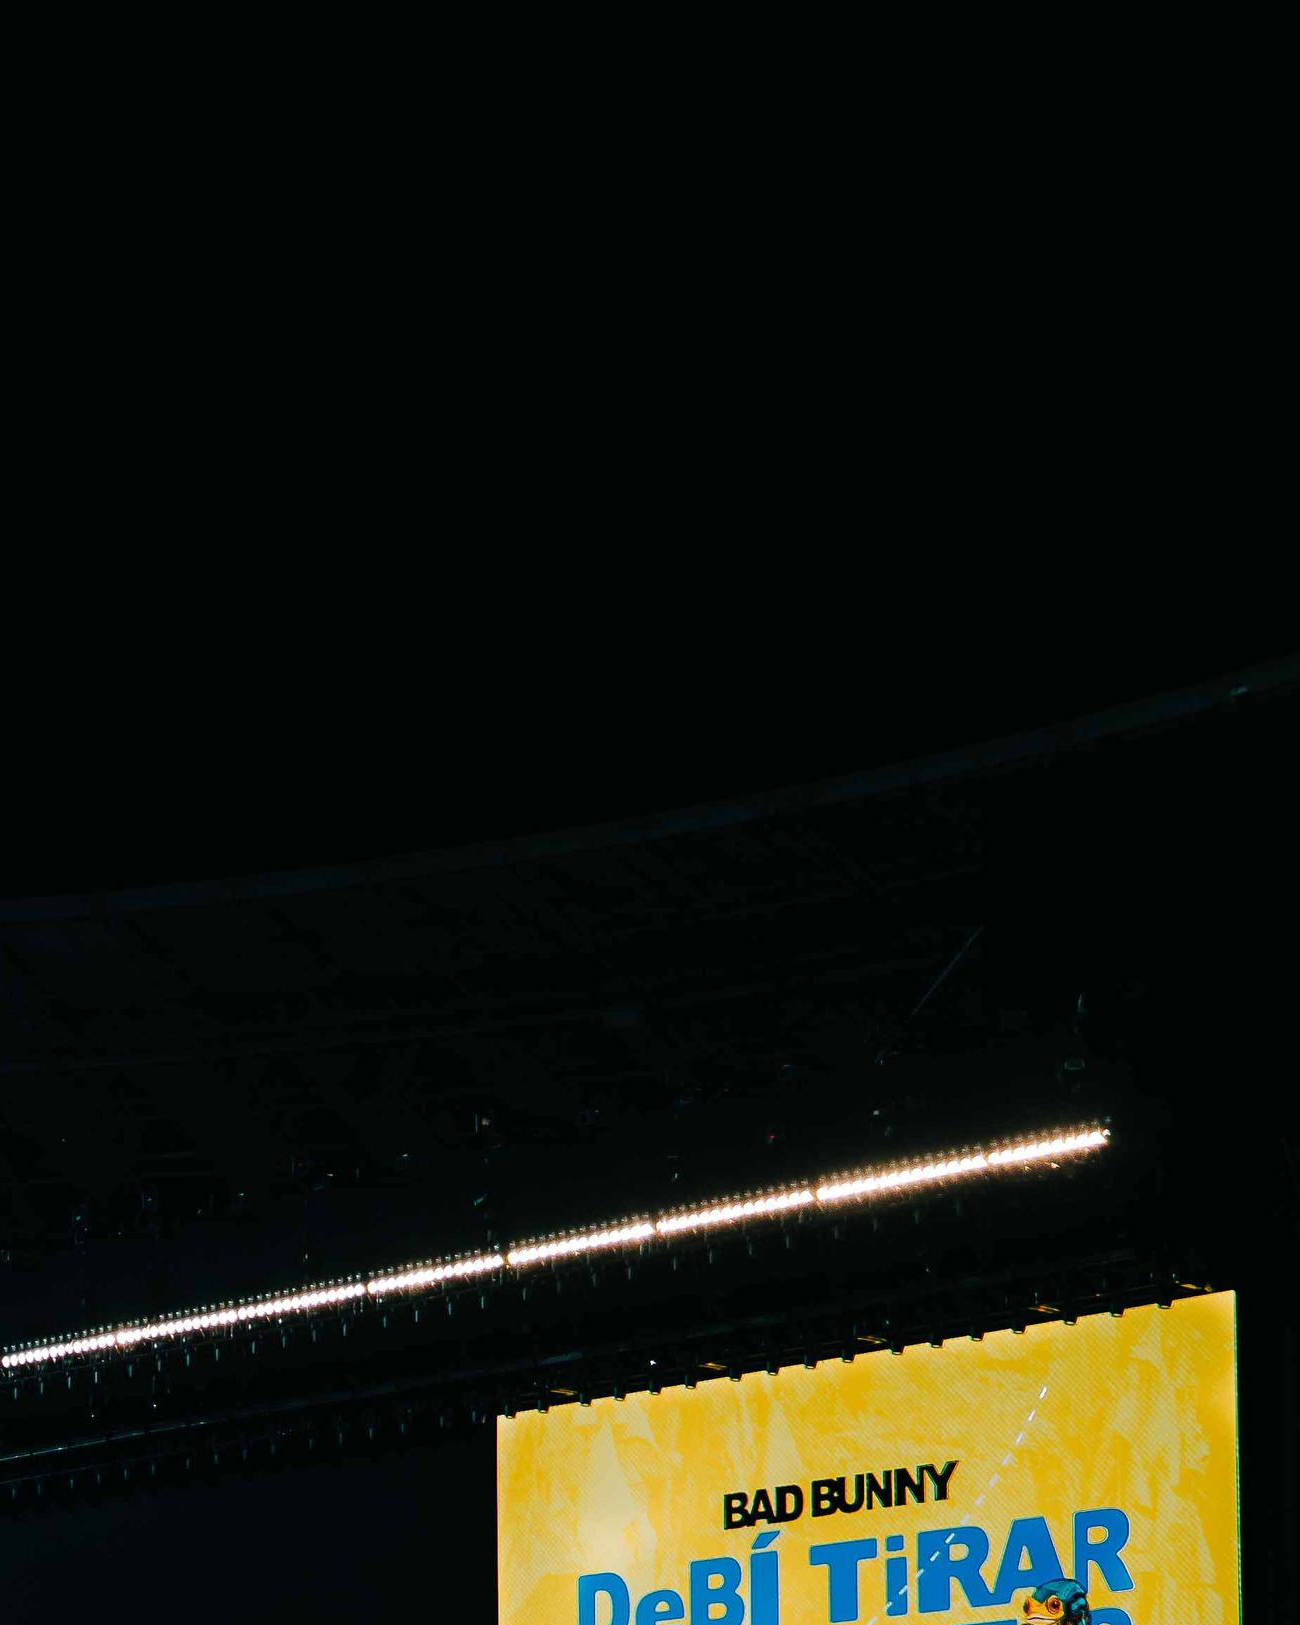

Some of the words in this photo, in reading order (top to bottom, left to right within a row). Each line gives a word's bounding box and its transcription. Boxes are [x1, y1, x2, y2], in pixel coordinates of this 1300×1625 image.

[723, 1484, 804, 1531] BAD
[810, 1460, 959, 1518] BUNNY
[808, 1507, 1136, 1624] TiRAR
